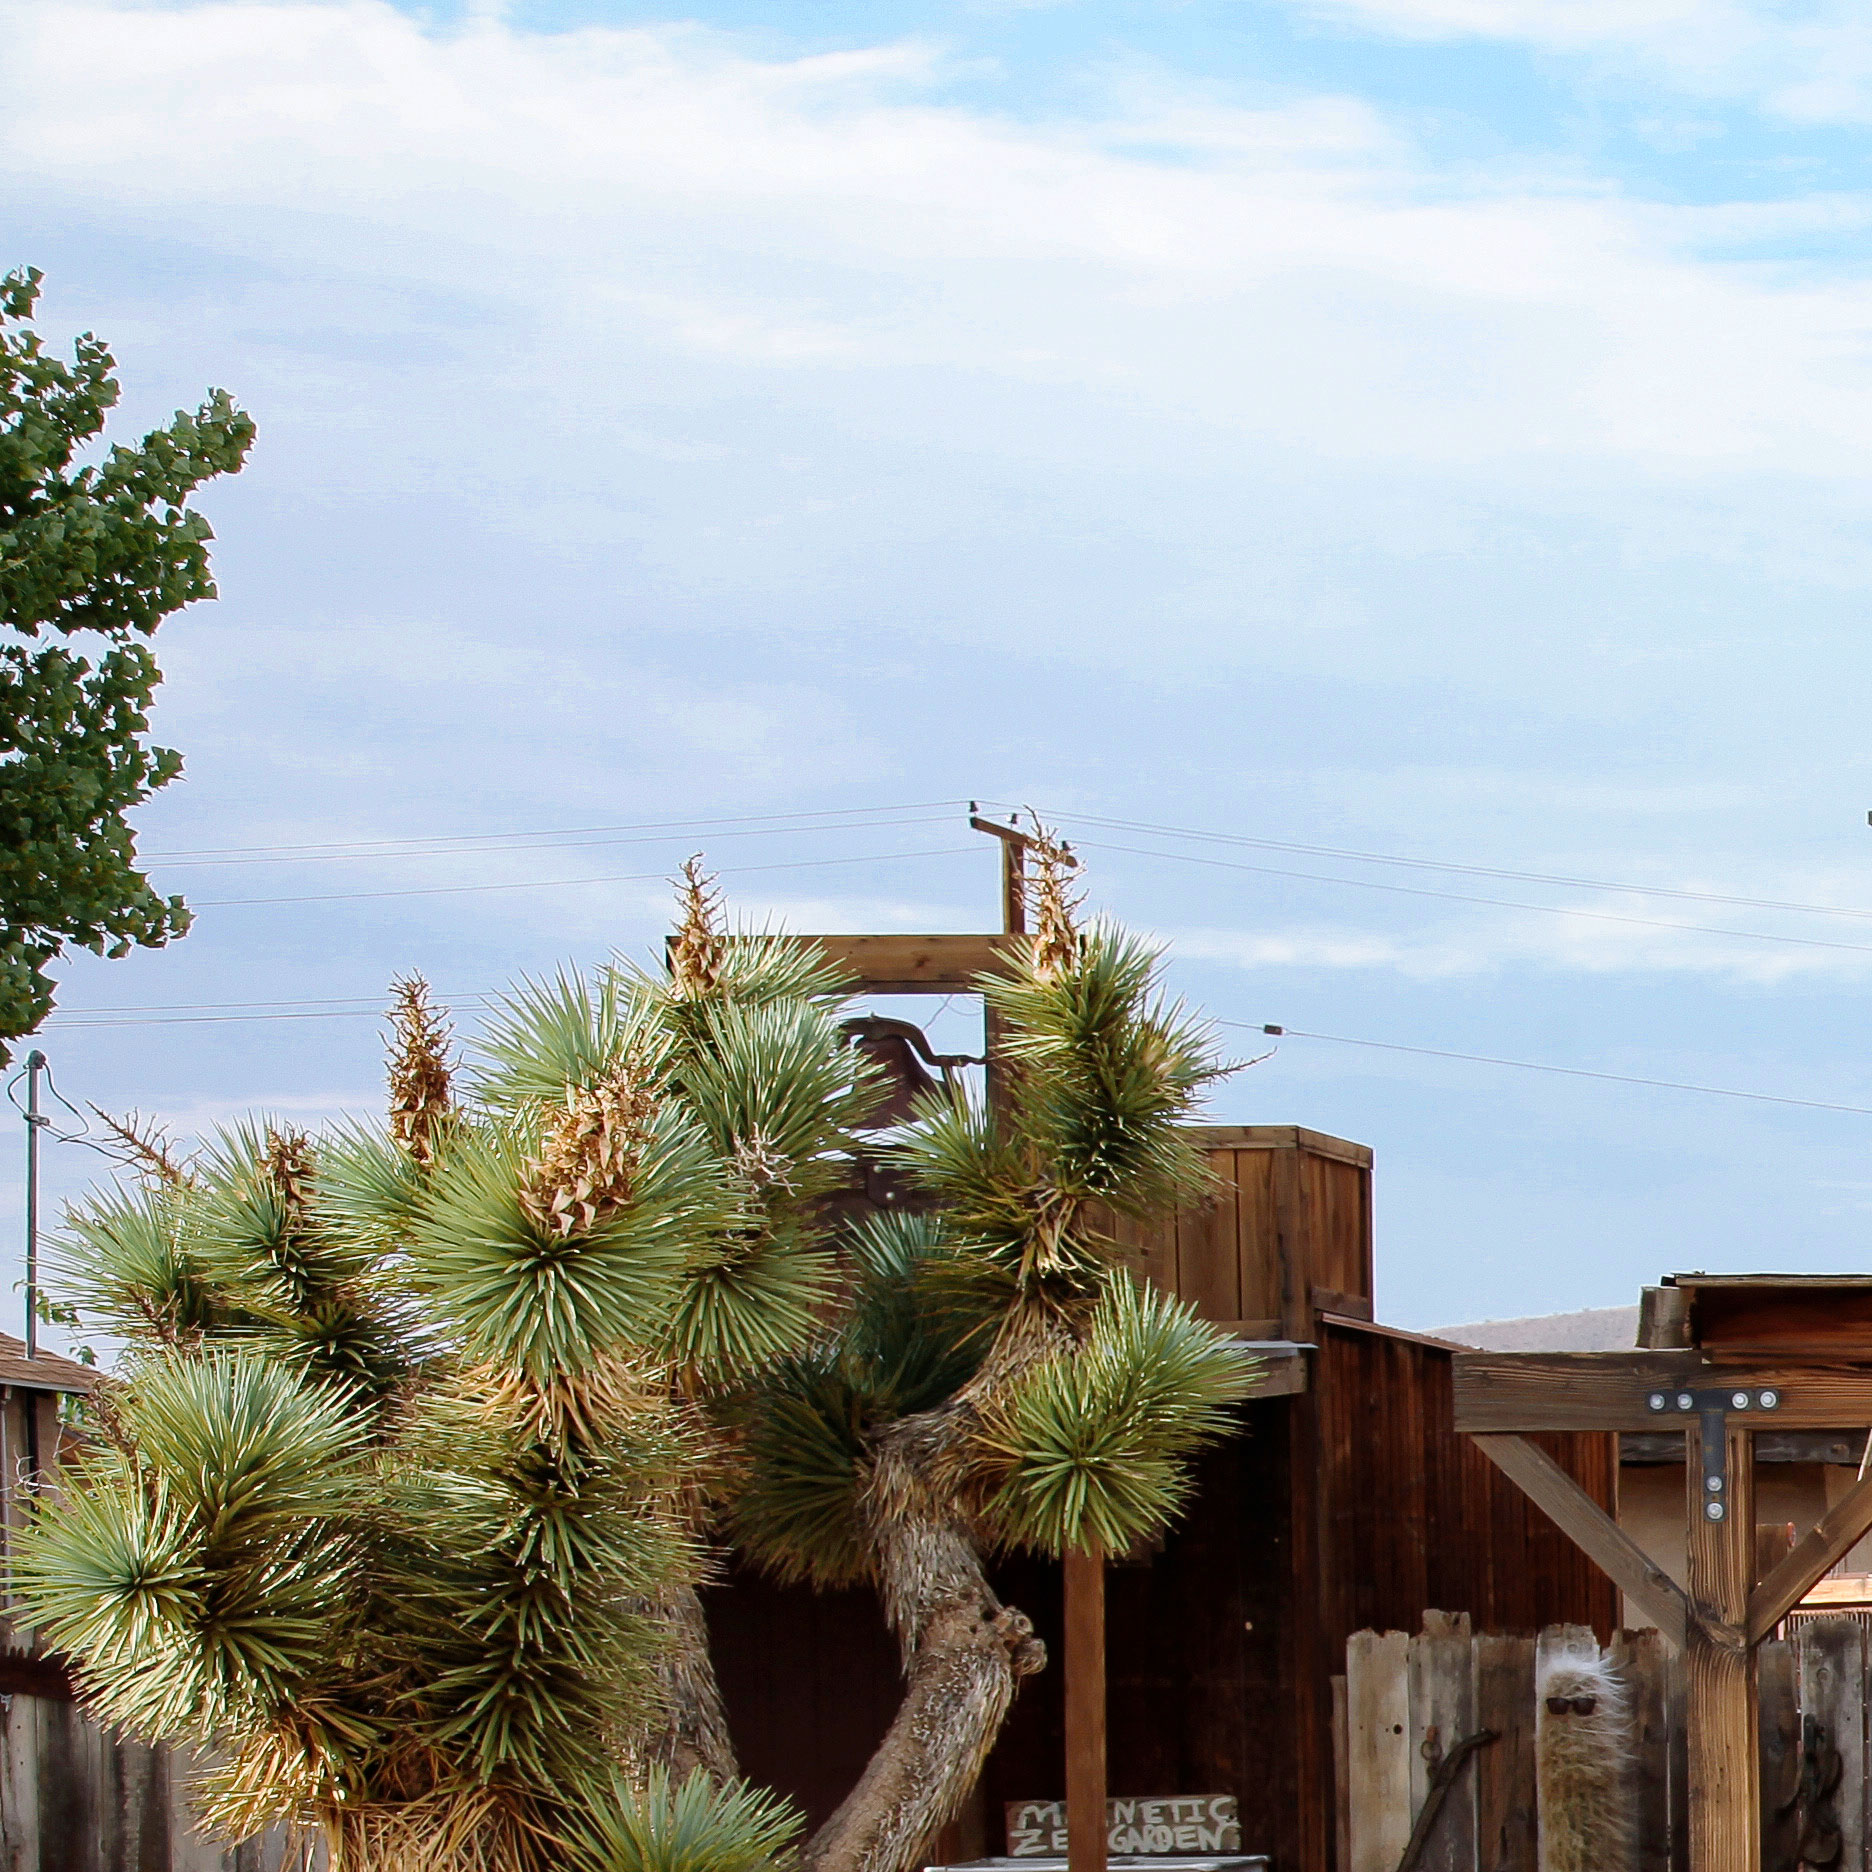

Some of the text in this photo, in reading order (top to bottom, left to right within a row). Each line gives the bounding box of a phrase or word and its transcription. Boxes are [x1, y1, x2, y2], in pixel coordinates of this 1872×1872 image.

[1017, 1797, 1238, 1829] MNETIC
[1010, 1822, 1241, 1856] ZE GARDEN
